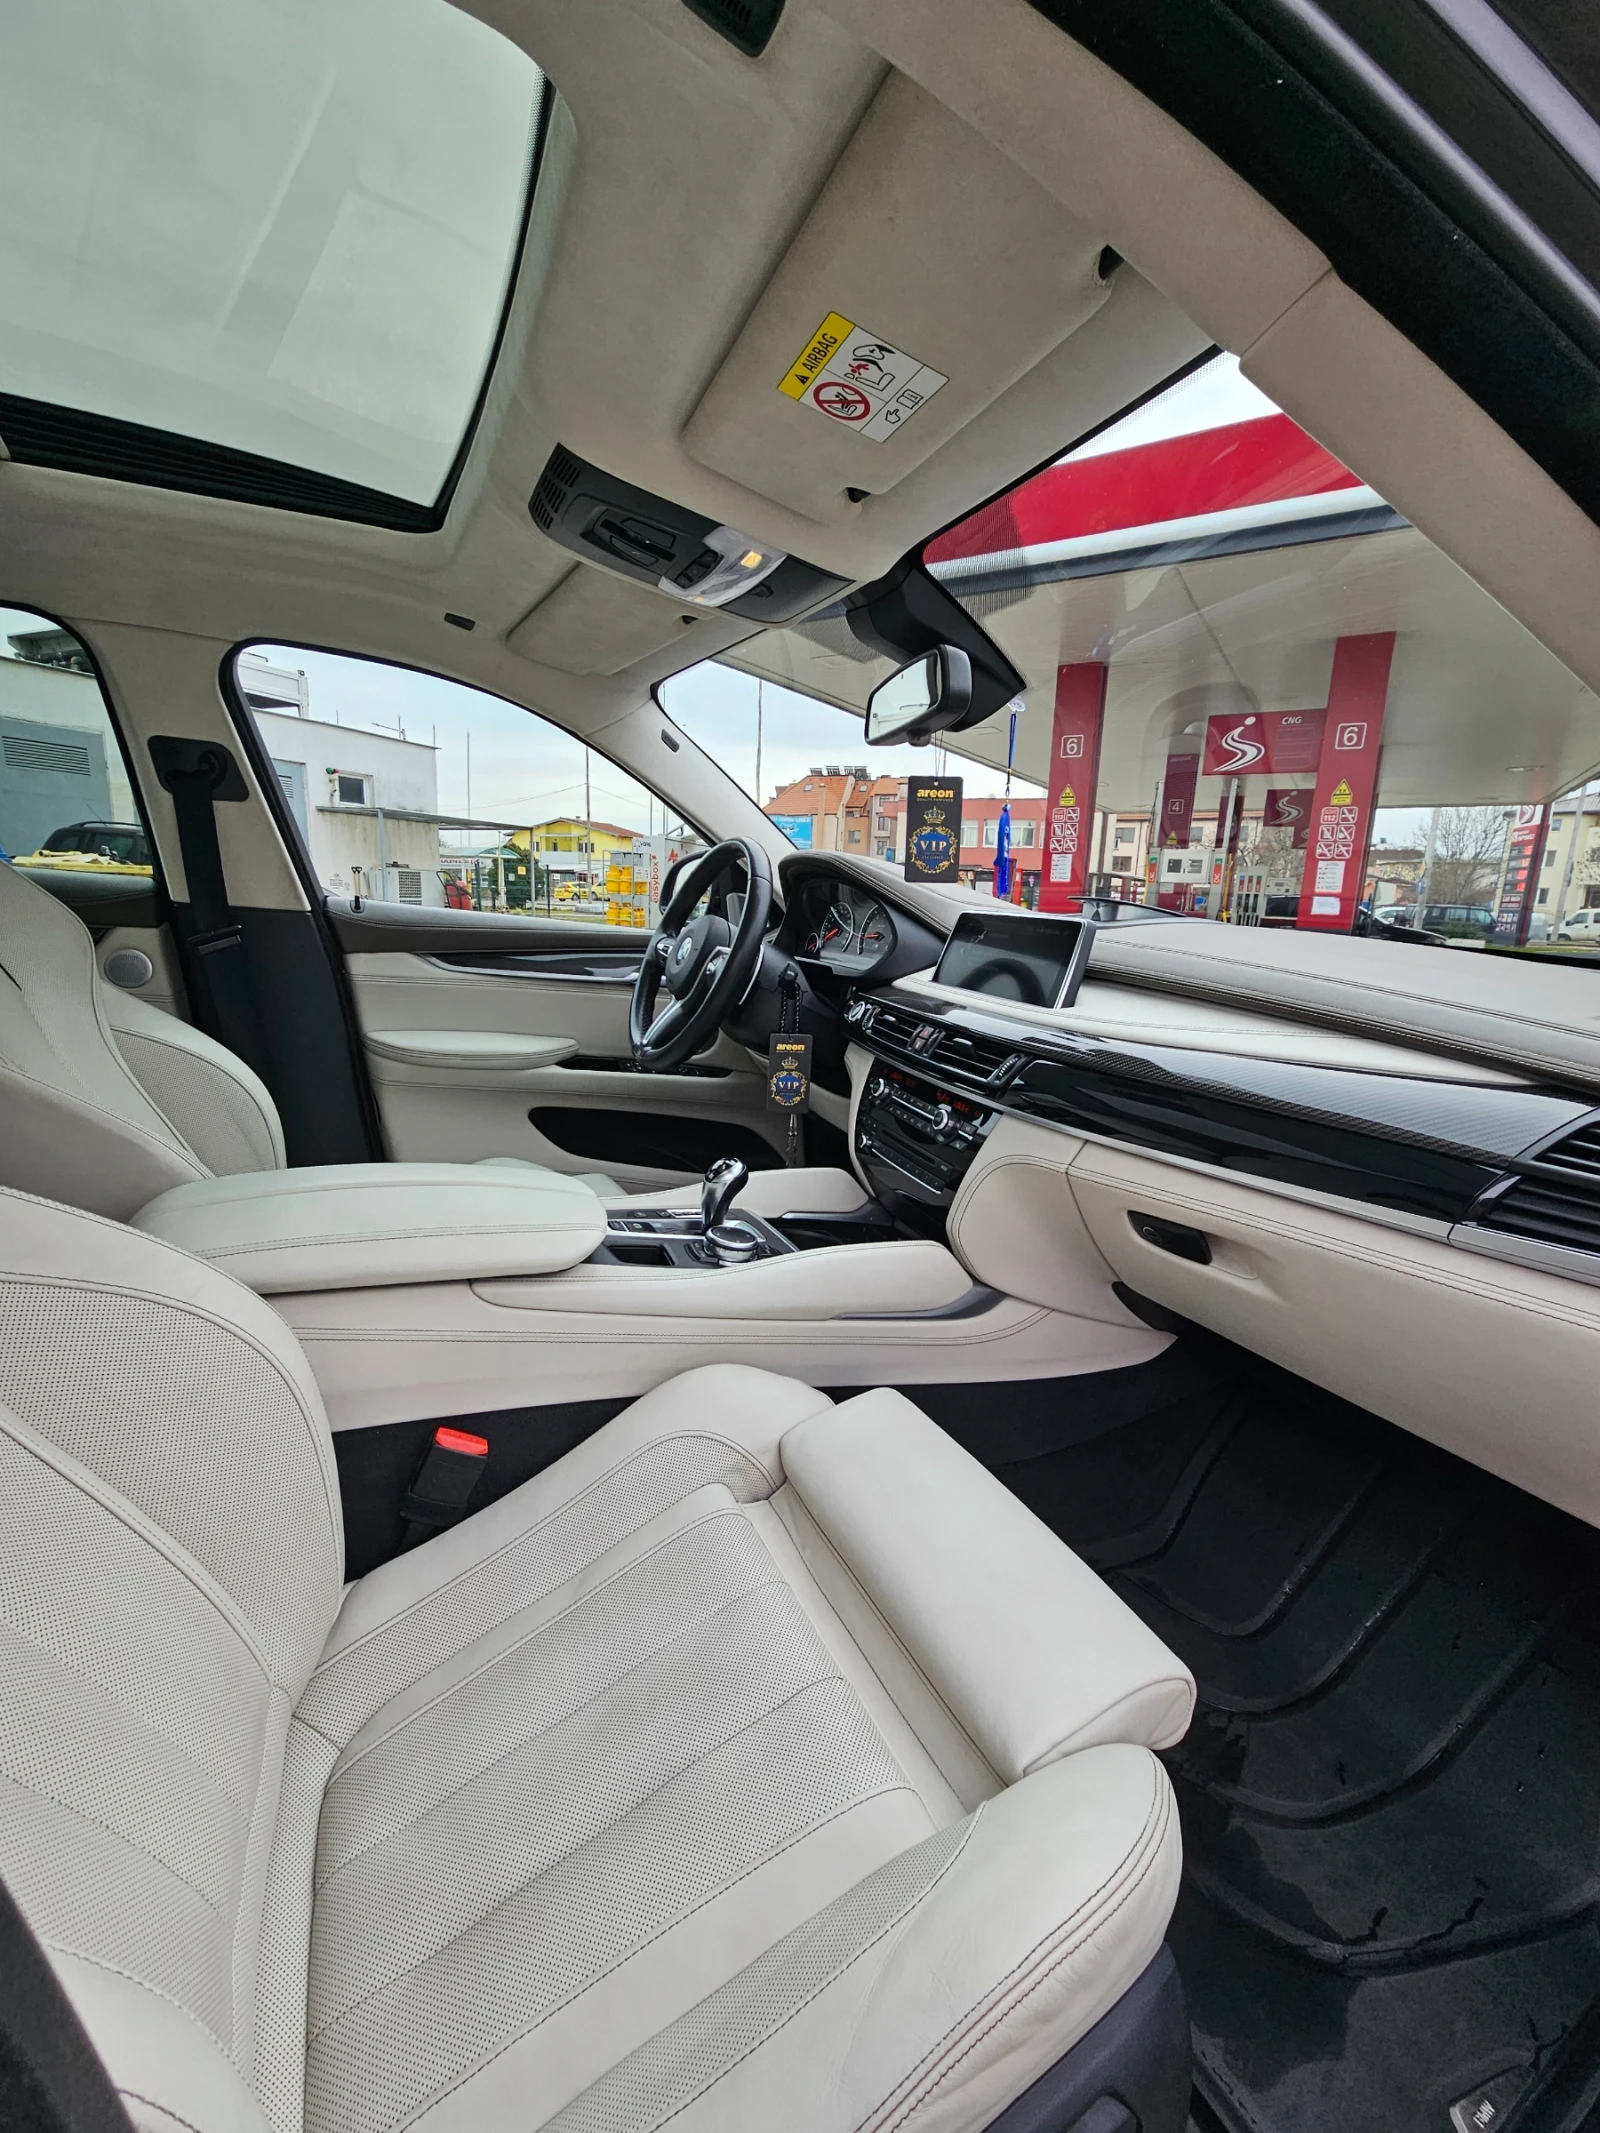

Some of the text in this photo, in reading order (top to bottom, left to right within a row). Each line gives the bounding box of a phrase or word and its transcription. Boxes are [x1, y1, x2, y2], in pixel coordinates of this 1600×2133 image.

[802, 333, 838, 373] AIRBAG
[1281, 716, 1302, 725] CNG
[1343, 727, 1358, 746] 6
[1066, 738, 1078, 754] 6
[917, 789, 954, 798] areon
[1172, 801, 1180, 811] 4
[920, 840, 947, 852] VIP
[651, 861, 660, 903] easybox
